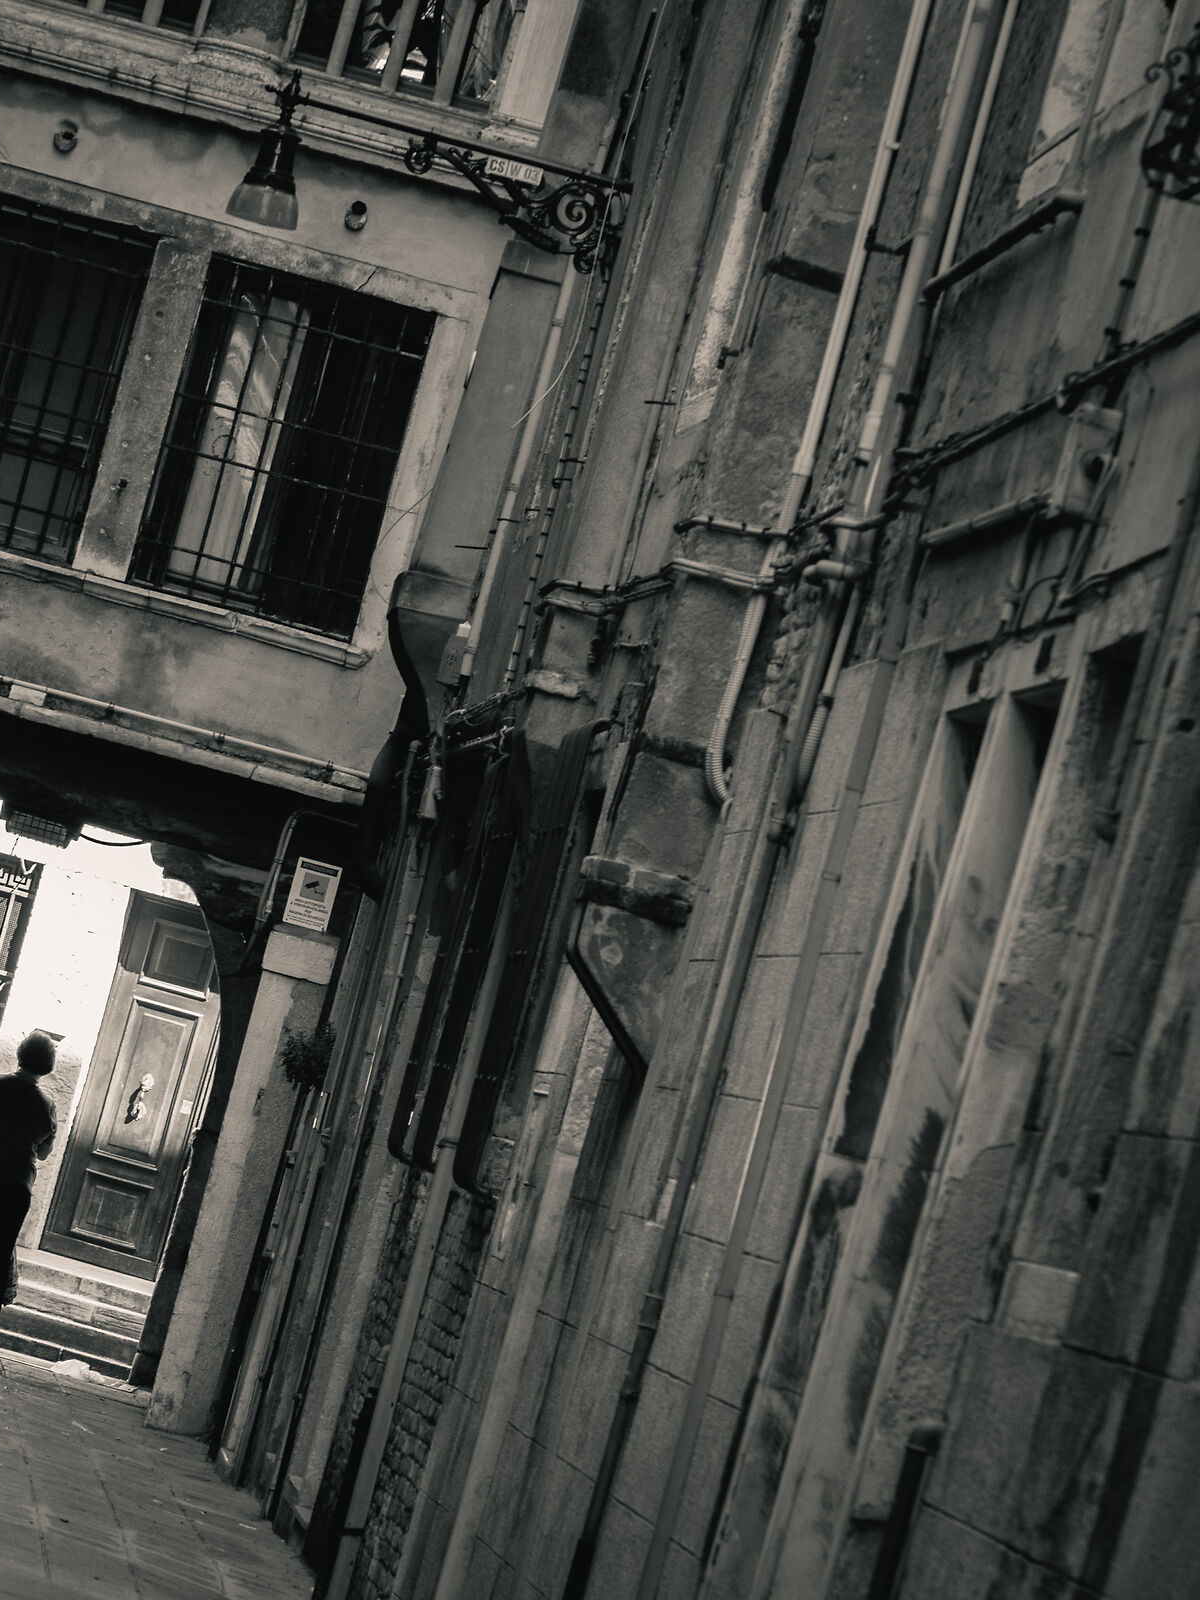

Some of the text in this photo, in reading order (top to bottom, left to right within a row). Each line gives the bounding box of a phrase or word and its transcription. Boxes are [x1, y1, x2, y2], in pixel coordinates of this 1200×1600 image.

[489, 159, 539, 181] CS W 03
